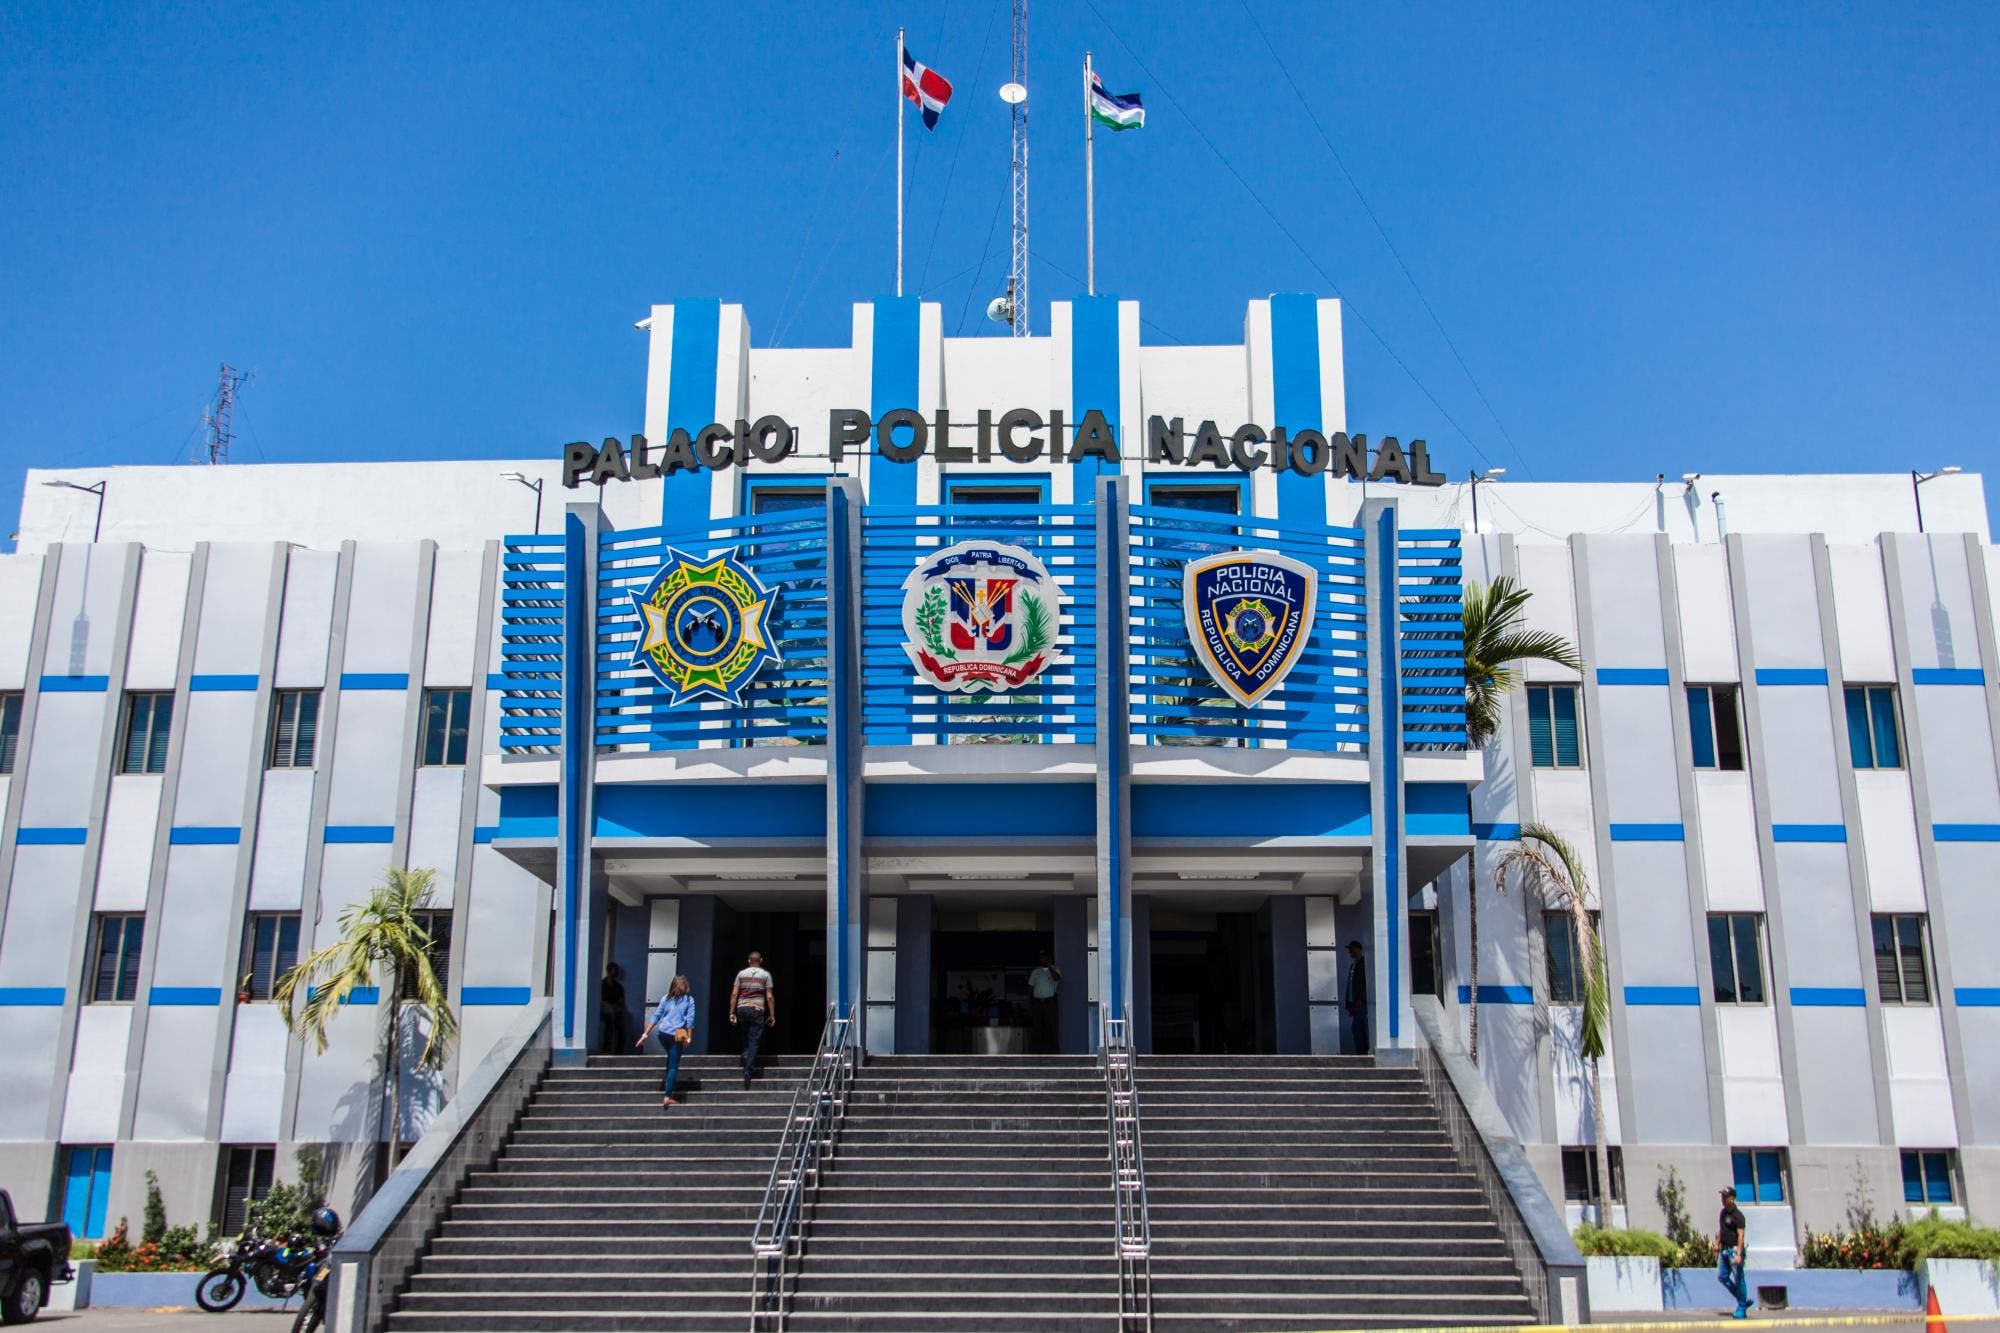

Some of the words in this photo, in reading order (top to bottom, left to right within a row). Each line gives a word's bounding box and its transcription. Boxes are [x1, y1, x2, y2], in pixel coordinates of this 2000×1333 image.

[563, 415, 793, 489] PALACIO
[830, 408, 1122, 464] POLICIA
[1148, 415, 1446, 487] NACIONAL
[998, 556, 1025, 570] LIBERTAD
[1216, 566, 1286, 585] POLICIA
[1207, 579, 1296, 603] NACIONAL
[668, 591, 693, 630] POLICIA
[700, 586, 740, 625] NACIONAL
[1201, 609, 1241, 680] REPUBLICA
[1255, 610, 1300, 681] DOMINICANA
[943, 664, 978, 674] REPUBLICA
[979, 664, 1017, 677] DOMINICANA
